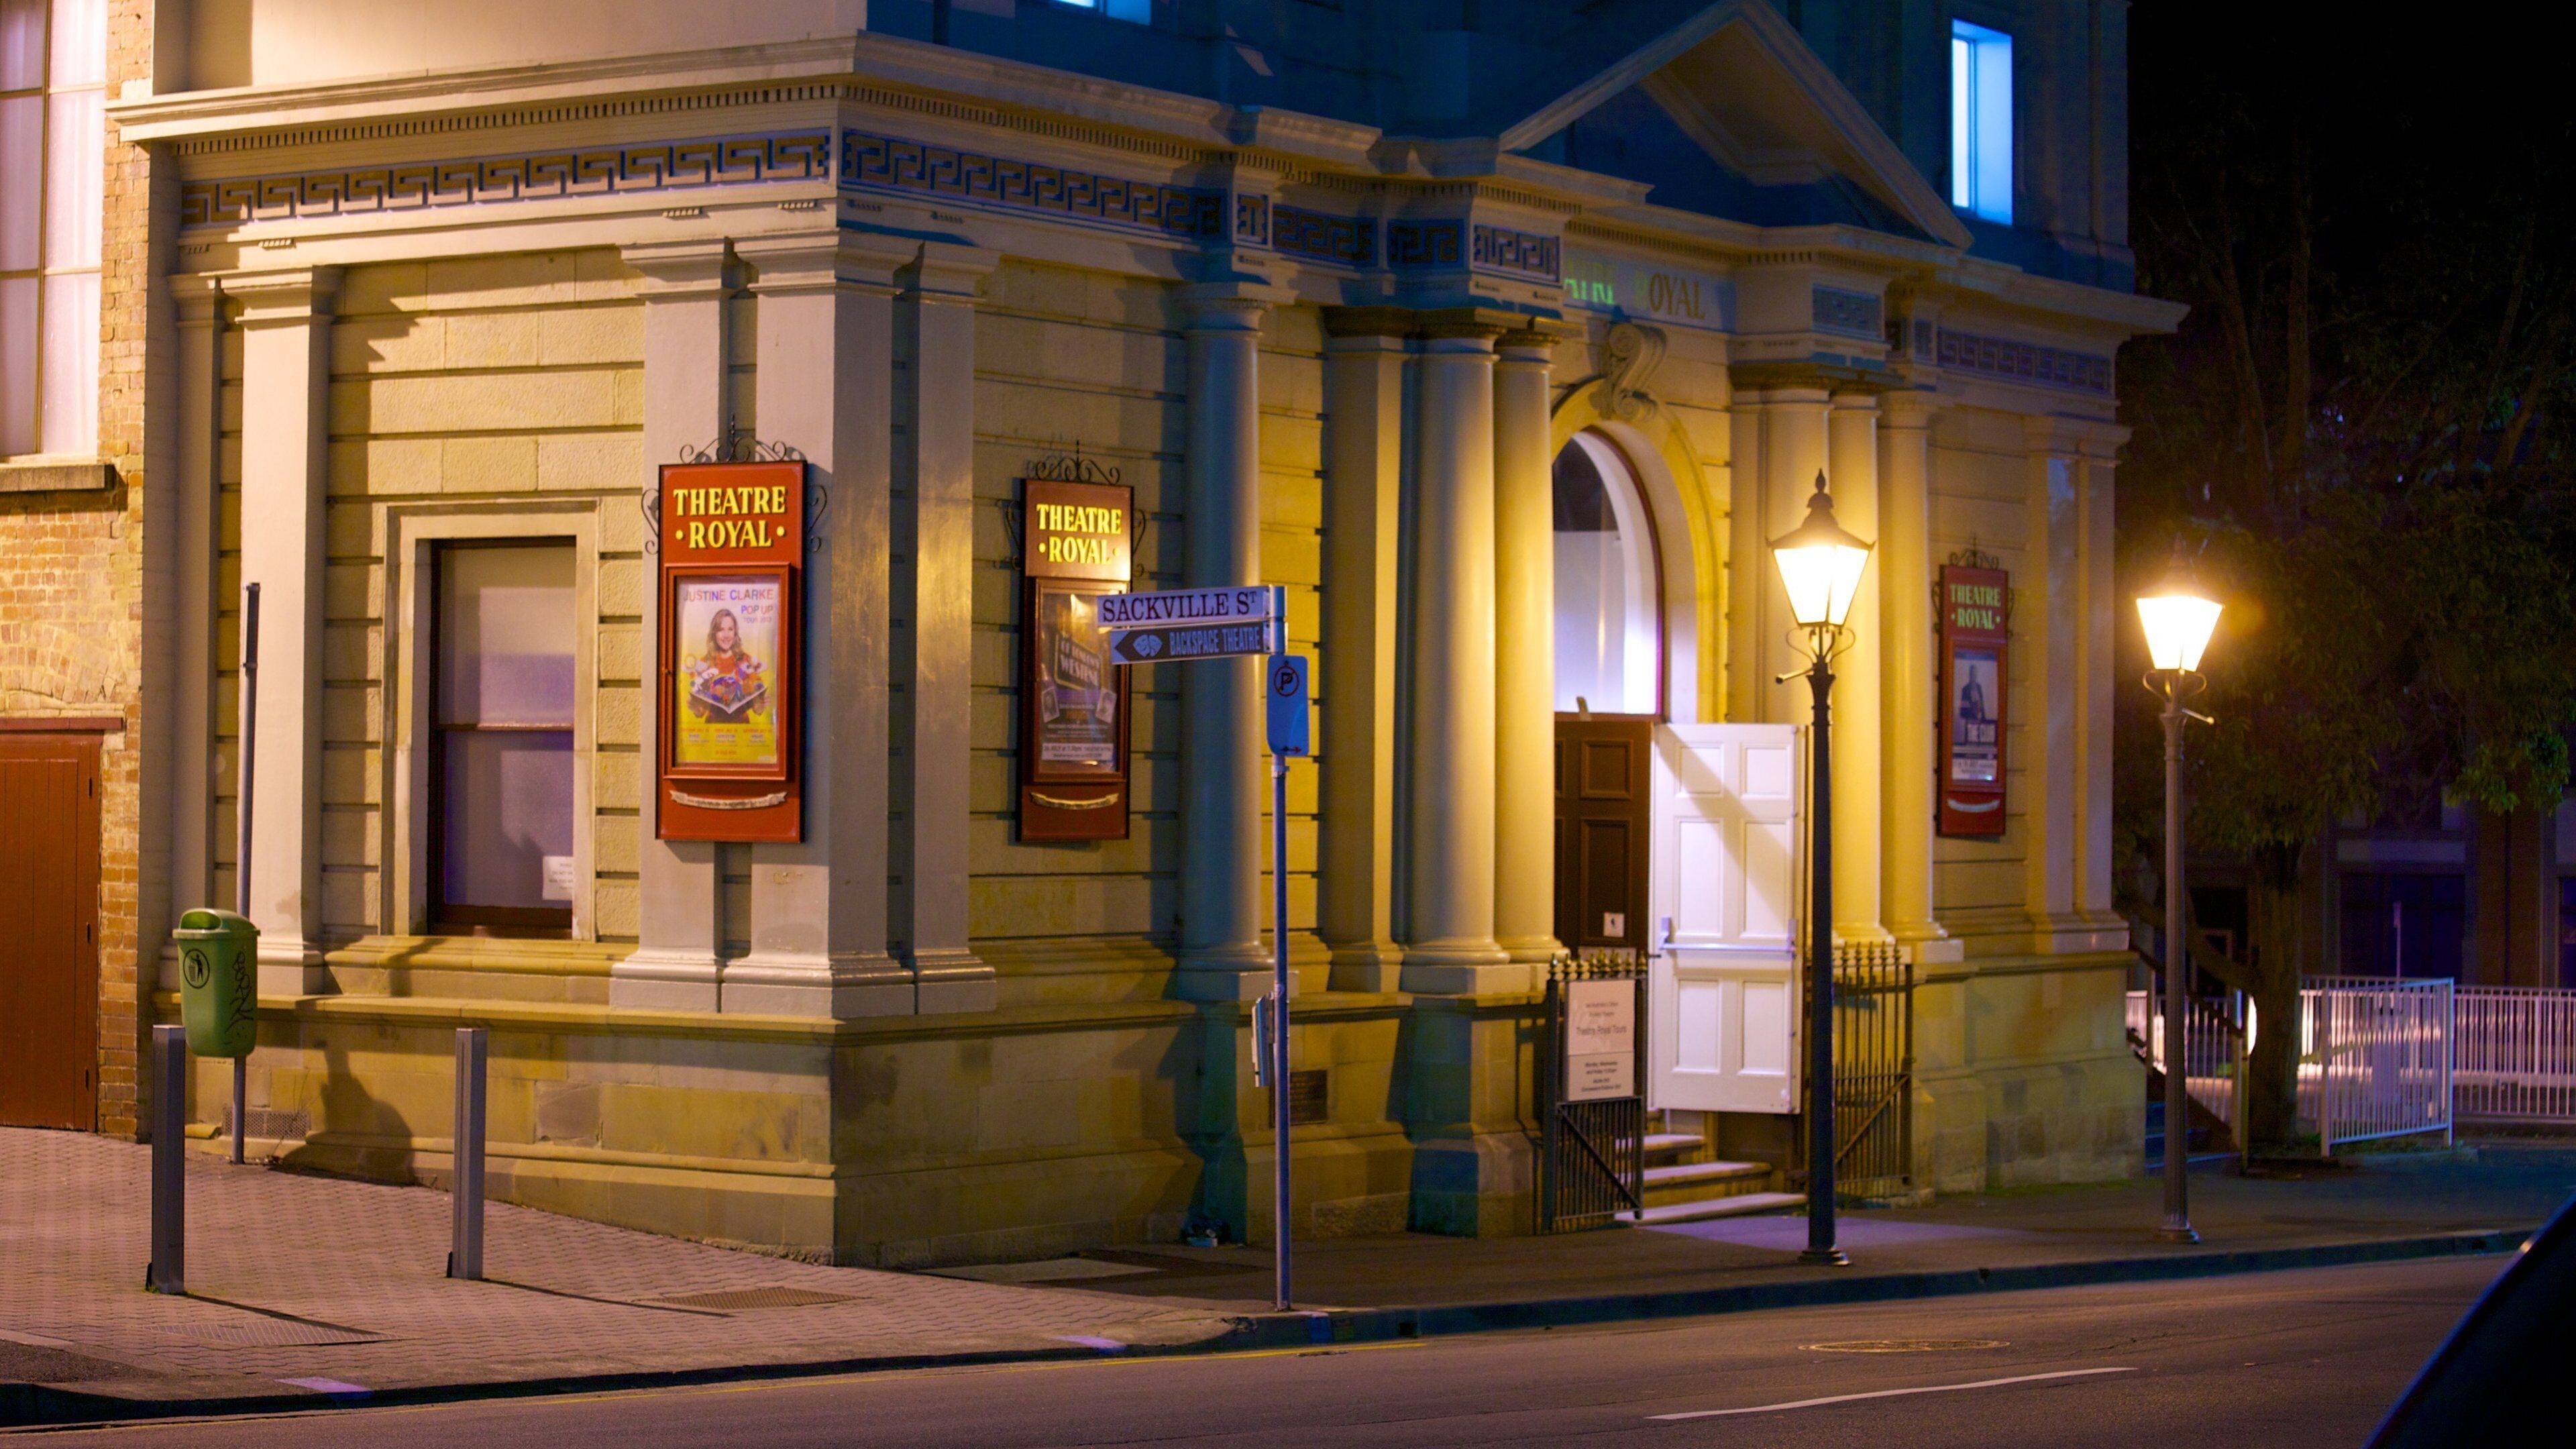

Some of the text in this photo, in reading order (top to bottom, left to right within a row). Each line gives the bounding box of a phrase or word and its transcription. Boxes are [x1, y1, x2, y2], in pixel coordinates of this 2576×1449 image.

[673, 486, 786, 517] THEATRE
[1036, 504, 1122, 535] THEATRE
[688, 519, 772, 549] ROYAL
[1048, 536, 1112, 564] ROYAL
[683, 589, 773, 602] JUSTINE CLARKE
[741, 605, 773, 614] POP UP
[1102, 591, 1257, 623] SACKVILLE ST
[1949, 584, 2001, 607] THEATRE
[1957, 607, 1995, 630] ROYAL
[1169, 627, 1260, 655] BACKSPACE THEATRE
